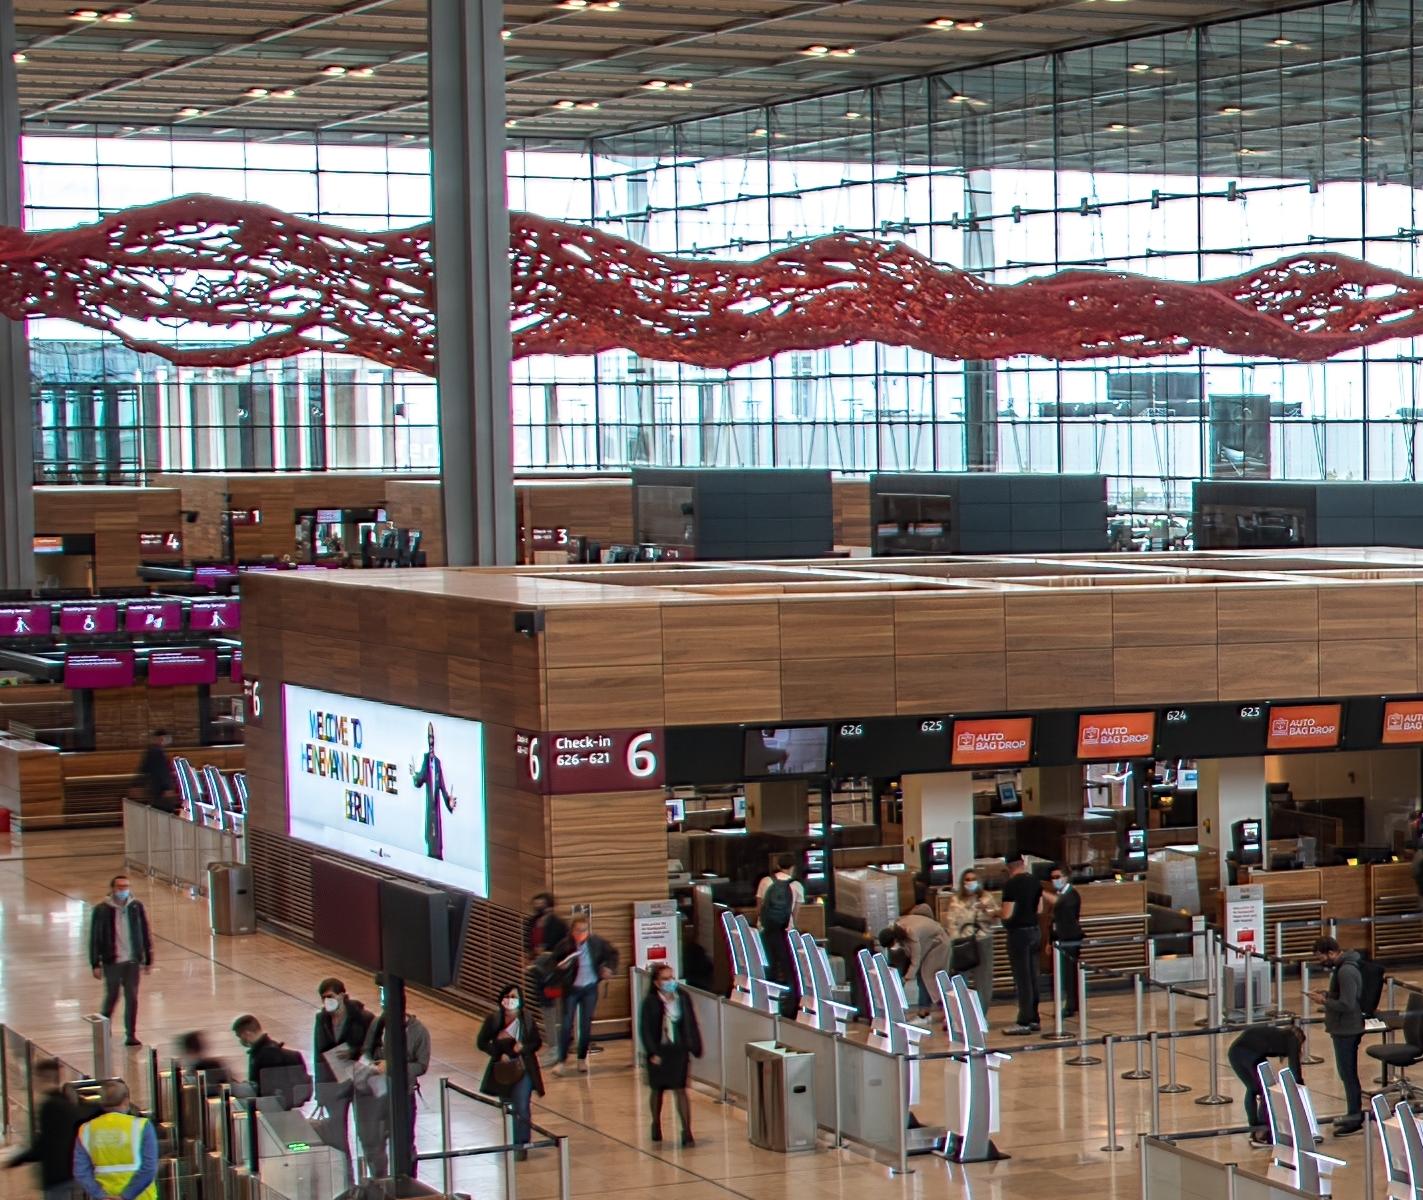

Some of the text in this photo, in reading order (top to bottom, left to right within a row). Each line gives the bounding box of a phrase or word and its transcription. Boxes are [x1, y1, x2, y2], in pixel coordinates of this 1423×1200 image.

[252, 510, 260, 523] 1
[166, 533, 180, 550] 4
[557, 529, 568, 544] 3
[252, 681, 260, 717] 6
[1167, 710, 1188, 721] 624
[1240, 707, 1260, 718] 623
[921, 720, 943, 732] 625
[1289, 718, 1315, 728] AUTO
[1403, 721, 1422, 731] BAG
[309, 710, 363, 750] WELCOME TO
[840, 724, 863, 736] 626
[1100, 726, 1128, 736] AUTO
[1288, 725, 1335, 737] BAG DROP
[555, 735, 611, 750] Check-in
[975, 732, 1005, 742] AUTO
[1100, 734, 1150, 744] BAG DROP
[975, 740, 1027, 751] BAG DROP
[529, 737, 540, 781] 6
[627, 732, 657, 777] 6
